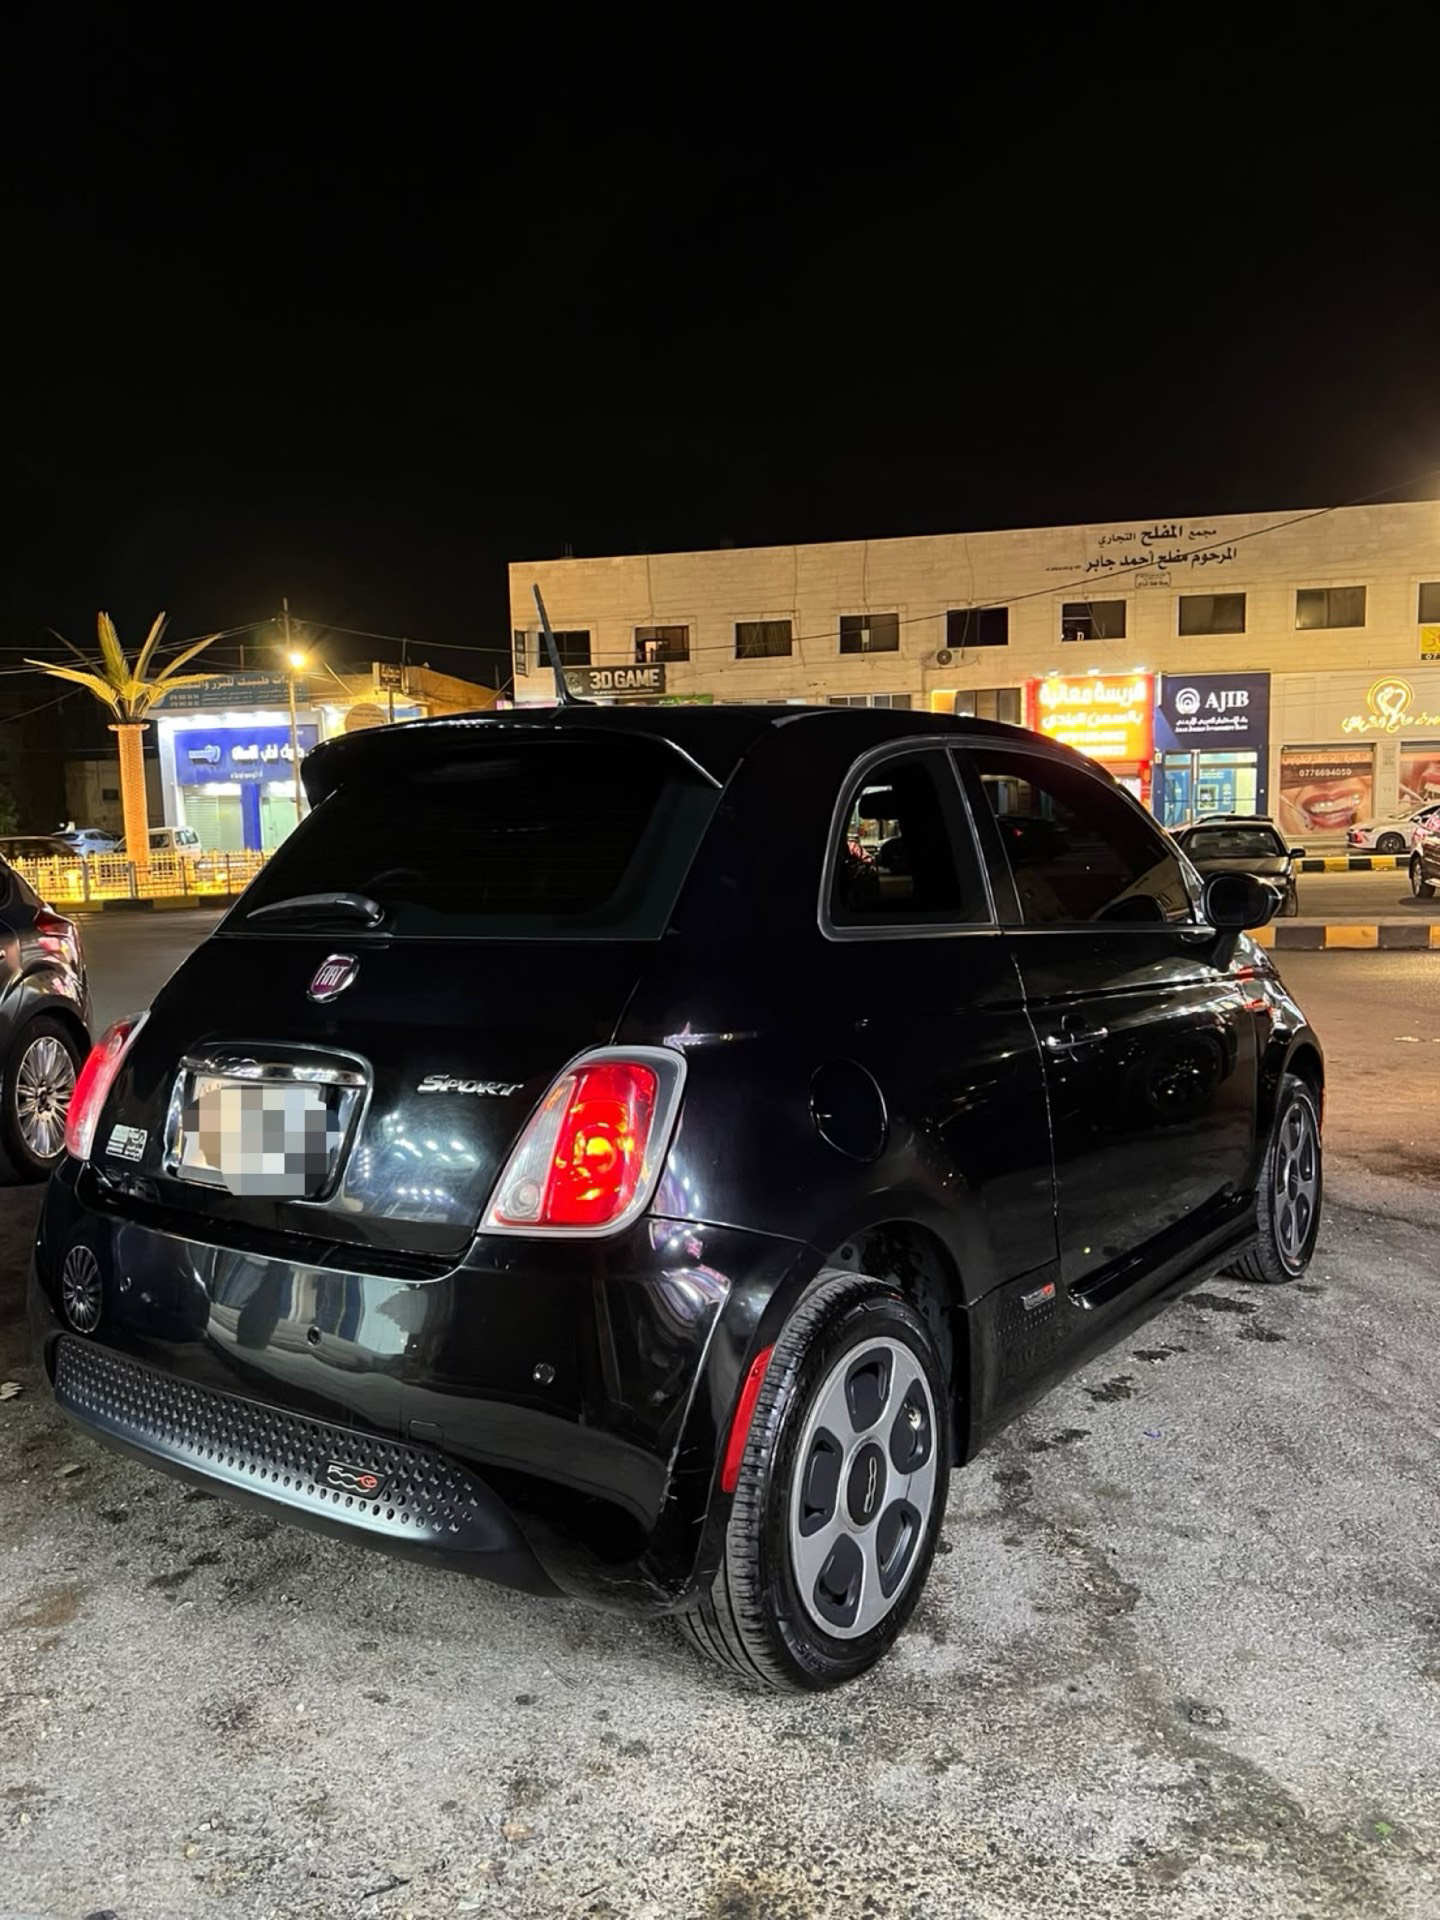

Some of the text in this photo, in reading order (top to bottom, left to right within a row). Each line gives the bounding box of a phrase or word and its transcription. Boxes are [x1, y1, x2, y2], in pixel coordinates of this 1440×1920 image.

[1097, 525, 1217, 549] مجمع المفلح التجاري
[1086, 554, 1116, 573] جابر
[1119, 550, 1155, 567] أحمد
[1191, 547, 1238, 570] المرحوم
[589, 668, 661, 690] 3D GAME
[1205, 690, 1250, 713] AJIB
[315, 965, 350, 987] FIAT
